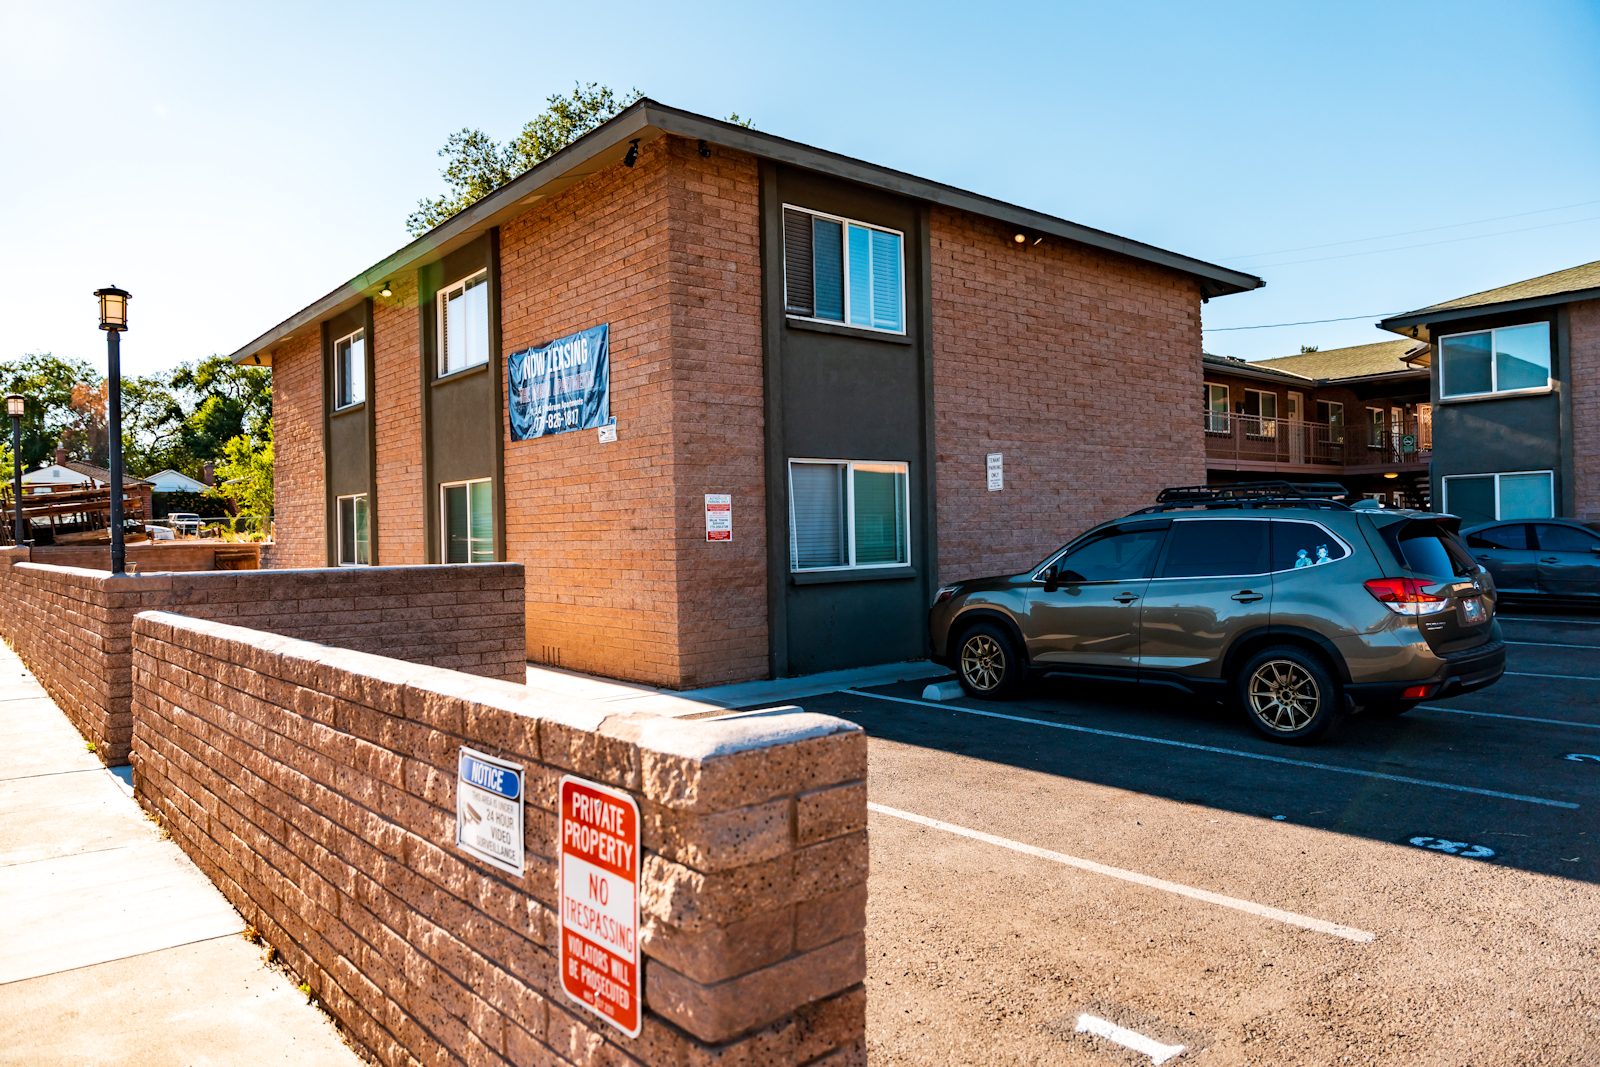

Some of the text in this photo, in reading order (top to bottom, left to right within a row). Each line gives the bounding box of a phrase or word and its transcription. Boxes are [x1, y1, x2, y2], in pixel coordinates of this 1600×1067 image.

[523, 338, 588, 380] NOW LEASING
[471, 761, 505, 793] NOTICE
[487, 808, 514, 830] 24 HOUR
[498, 801, 514, 815] UNDER
[572, 791, 625, 837] PRIVATE
[476, 834, 516, 861] SURVEILLANCE
[490, 826, 512, 845] VIDEO
[564, 819, 633, 872] PROPERTY
[589, 872, 608, 906] NO
[565, 896, 634, 953] TRESPASSING
[567, 934, 631, 988] VIOLATORS WILL
[568, 957, 579, 980] BE
[581, 964, 630, 1010] PROSECUTED
